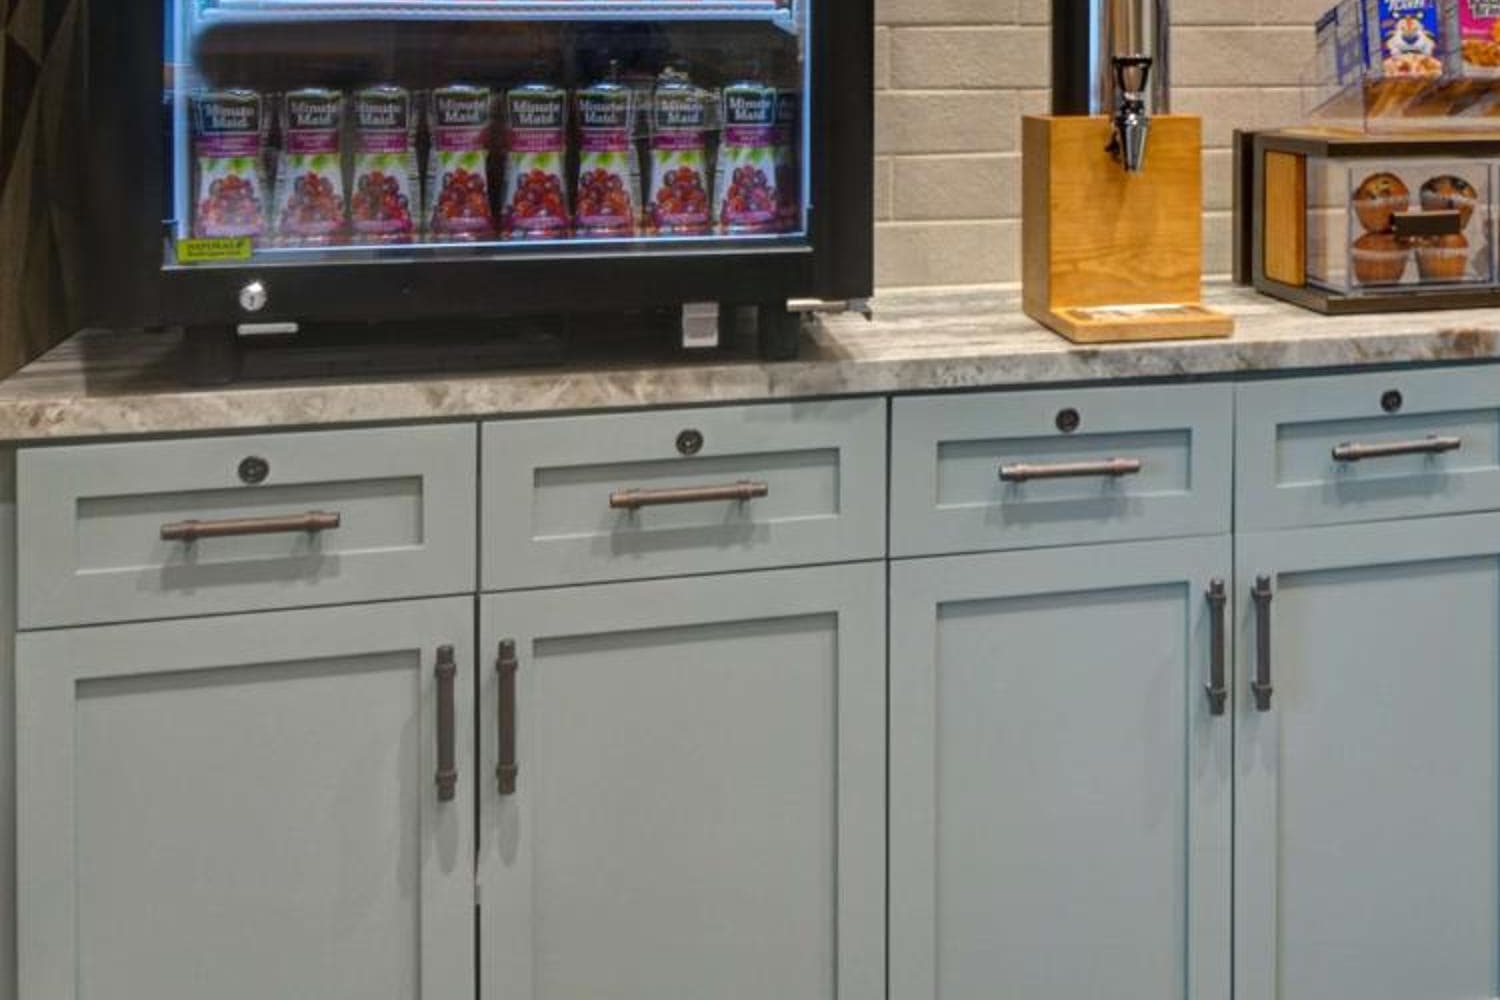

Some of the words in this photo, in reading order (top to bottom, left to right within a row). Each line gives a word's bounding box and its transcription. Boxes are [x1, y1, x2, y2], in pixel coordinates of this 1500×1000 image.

[513, 99, 560, 114] Minute
[729, 97, 772, 111] Minute
[518, 111, 555, 124] Maid
[734, 108, 767, 121] Maid
